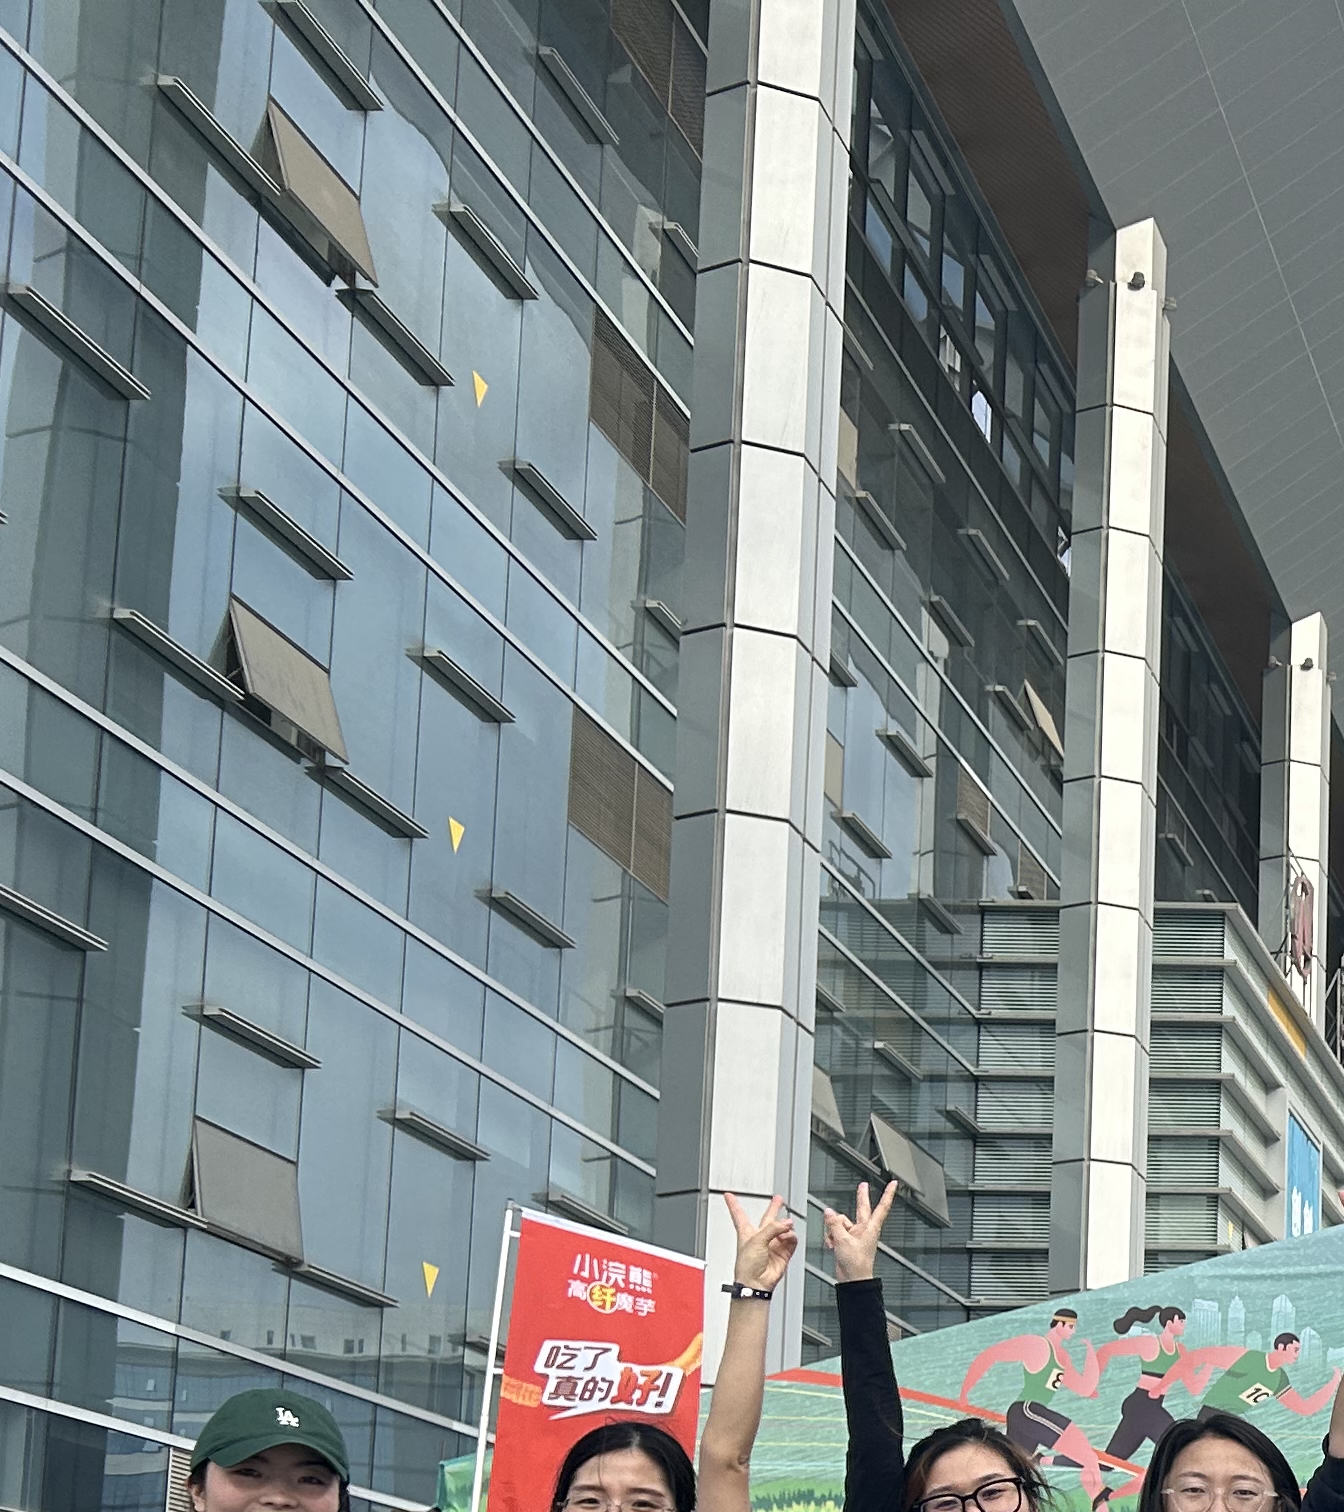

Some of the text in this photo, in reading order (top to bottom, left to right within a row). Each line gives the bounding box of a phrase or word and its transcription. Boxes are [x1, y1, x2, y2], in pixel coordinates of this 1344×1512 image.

[573, 1253, 652, 1294] 小浣熊
[543, 1345, 613, 1371] 吃了
